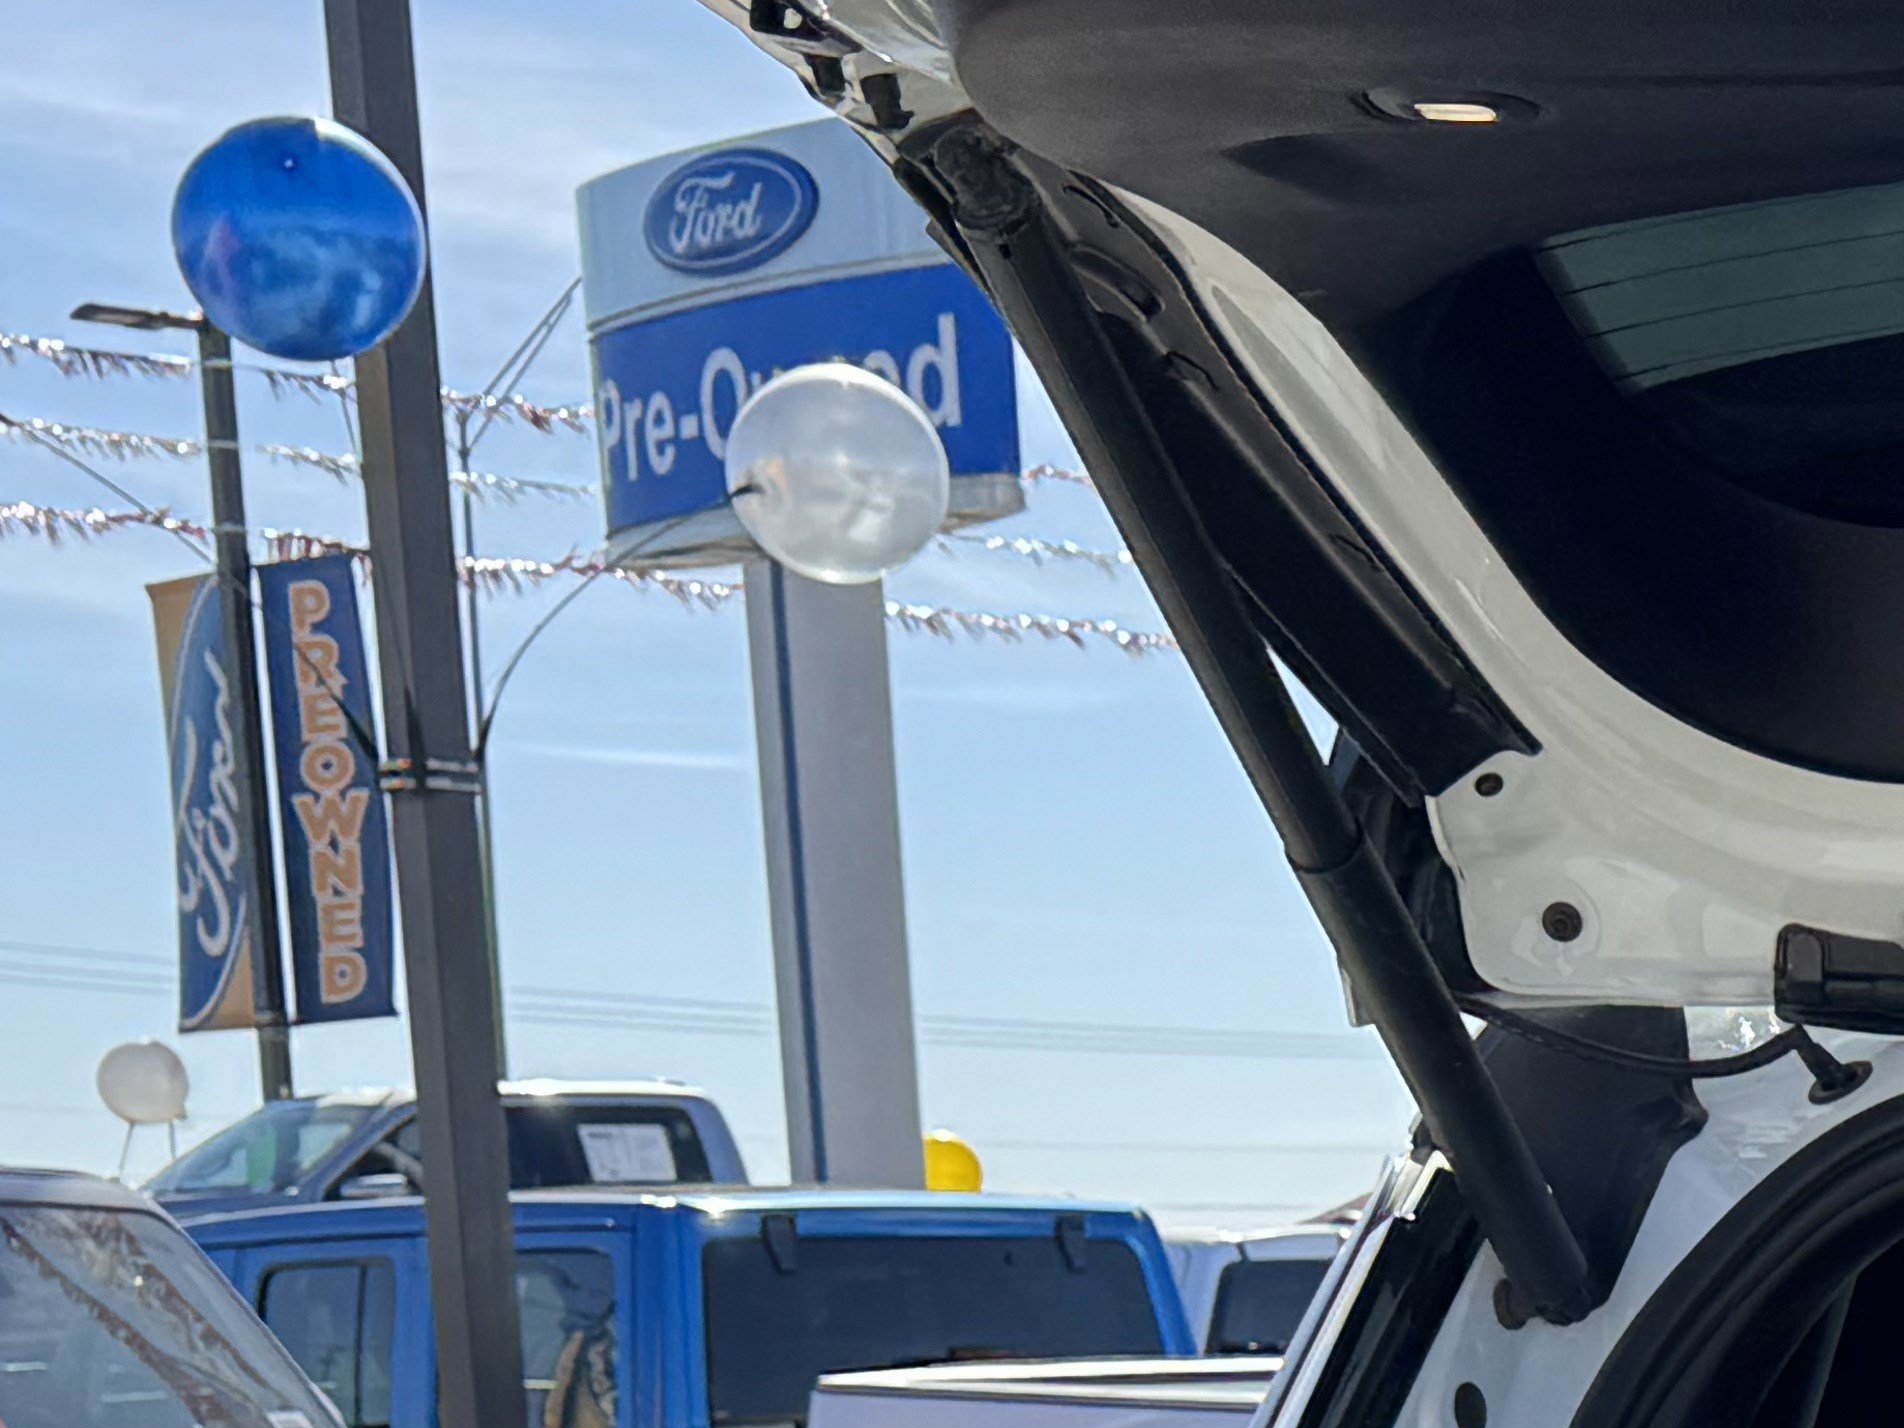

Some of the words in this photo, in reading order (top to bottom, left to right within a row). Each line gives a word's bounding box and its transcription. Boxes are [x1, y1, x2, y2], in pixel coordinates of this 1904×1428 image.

[668, 169, 764, 256] Ford
[600, 312, 963, 482] Pre-Od
[287, 579, 369, 1004] PREOWNED
